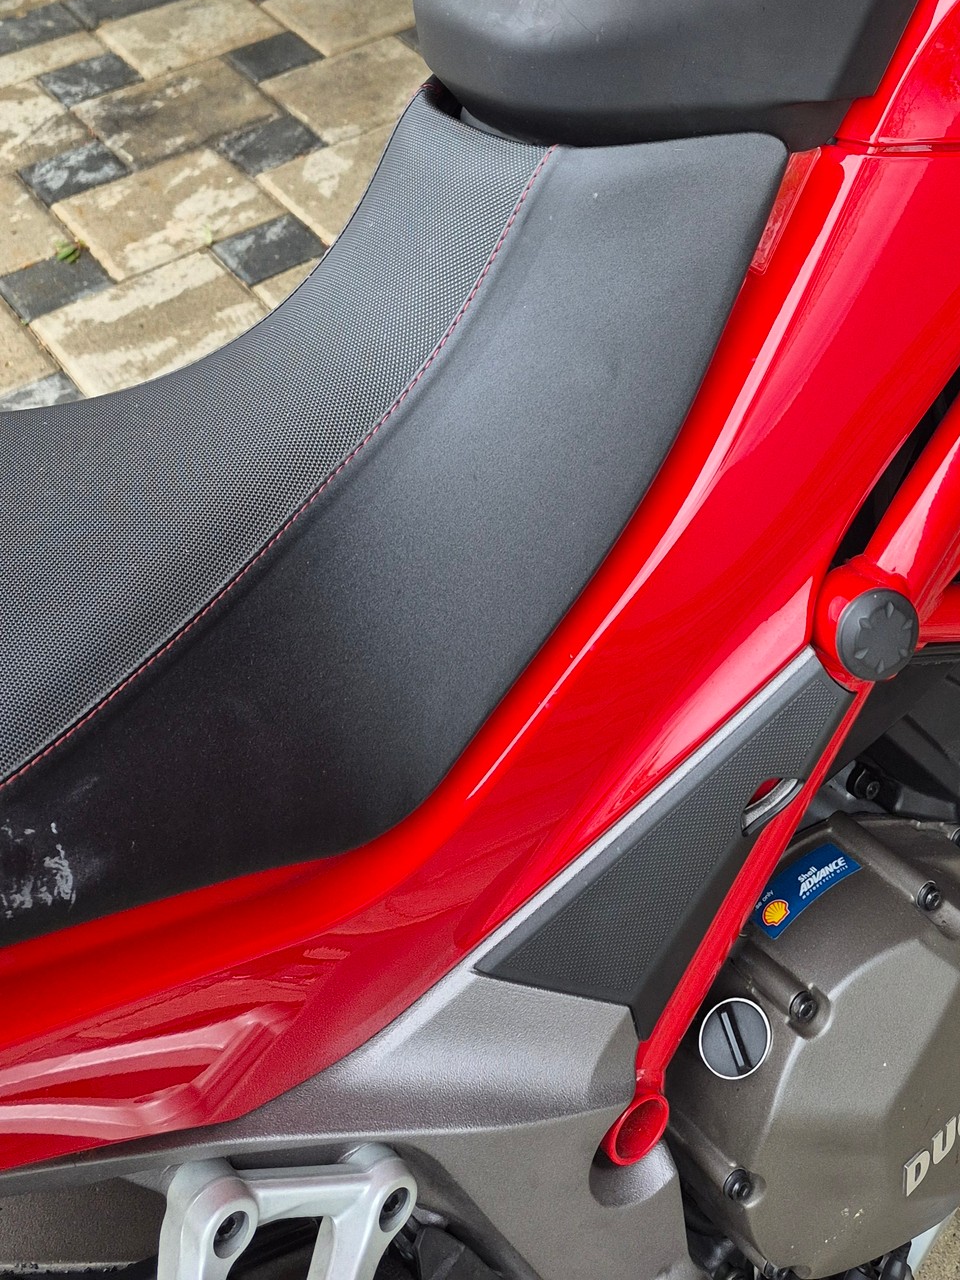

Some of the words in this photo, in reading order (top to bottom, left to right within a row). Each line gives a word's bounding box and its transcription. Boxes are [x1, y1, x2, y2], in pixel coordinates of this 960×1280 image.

[797, 865, 818, 883] Shell
[799, 856, 847, 897] ADVANCE
[761, 889, 774, 902] only
